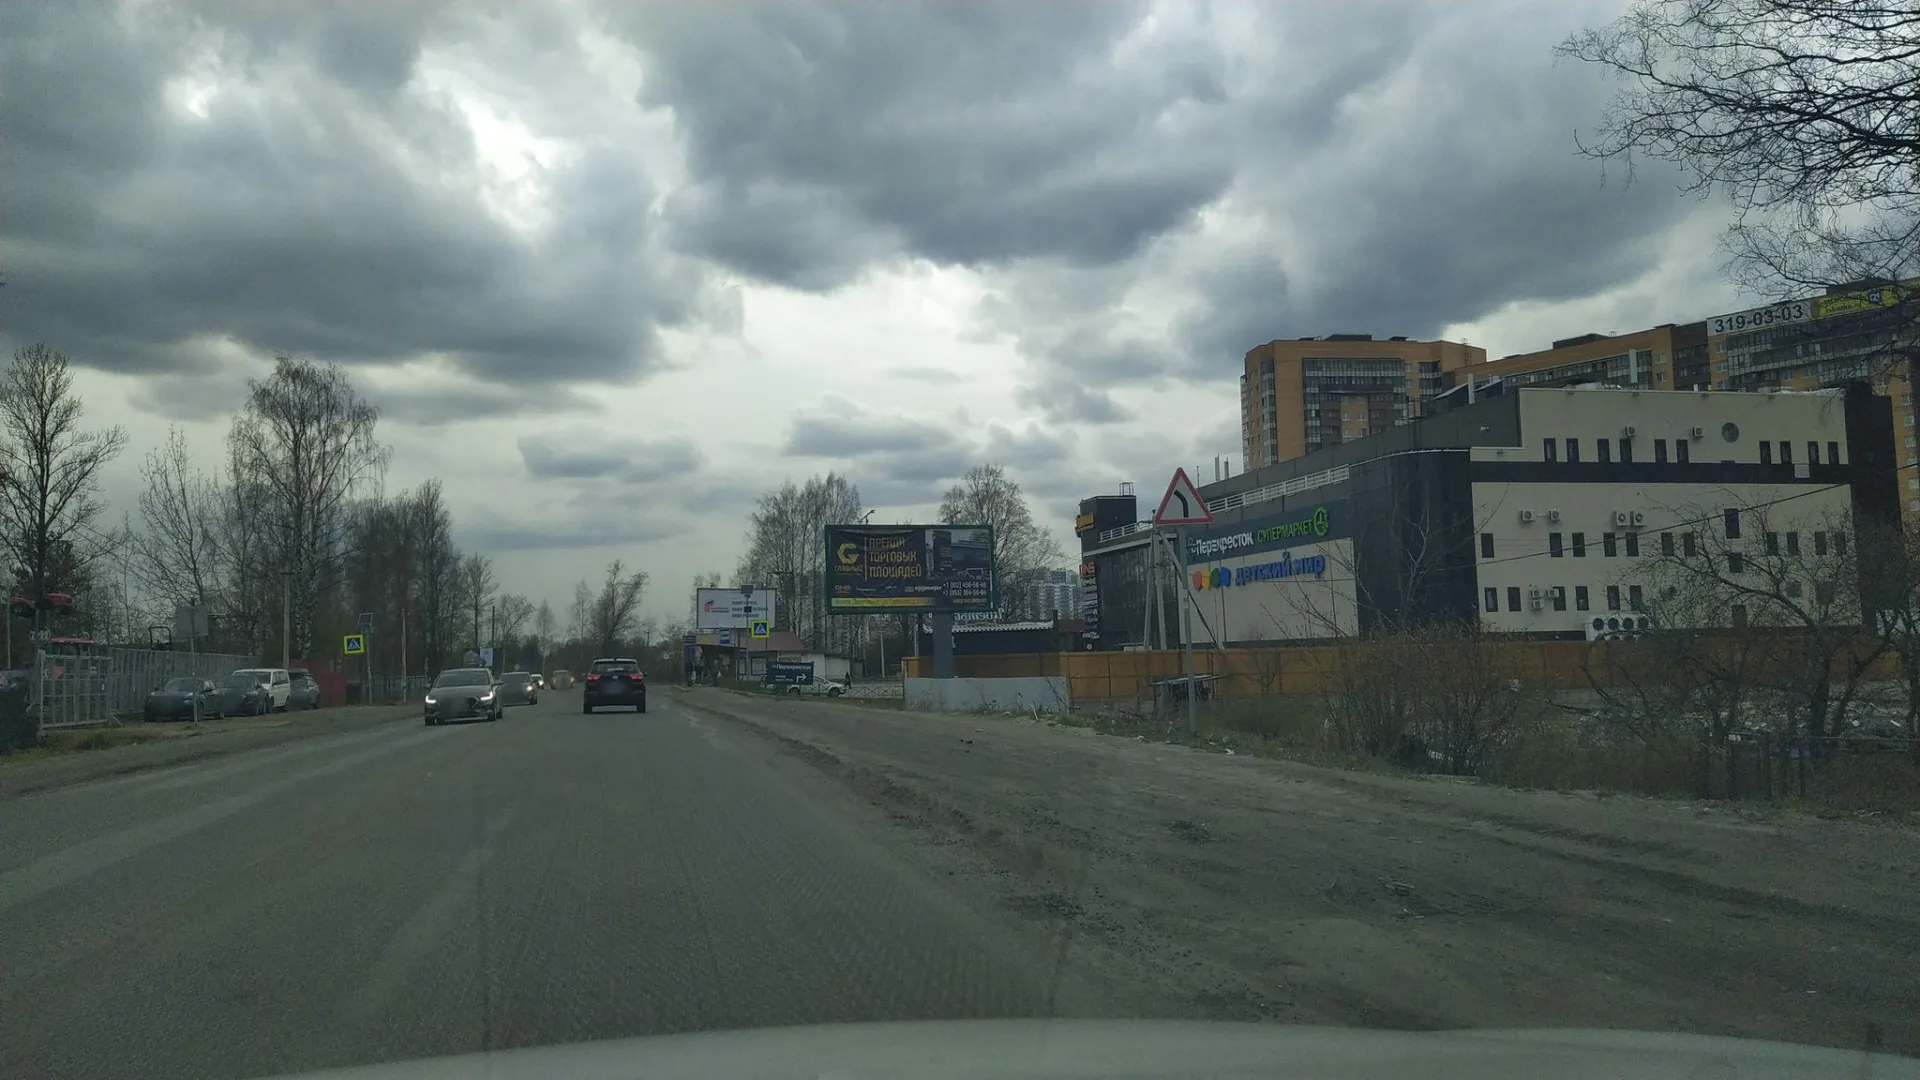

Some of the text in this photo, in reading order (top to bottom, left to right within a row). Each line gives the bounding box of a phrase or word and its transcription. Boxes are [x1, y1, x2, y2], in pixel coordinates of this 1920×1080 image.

[1714, 304, 1803, 333] 319-03-03
[869, 537, 905, 548] АРЕНДА
[1196, 519, 1313, 557] Перекресток СУПЕРМАРКЕТ
[870, 551, 917, 563] ТОРГОВЫХ
[869, 564, 922, 578] ПЛОЩАДЕЙ
[1235, 551, 1325, 586] детский мир
